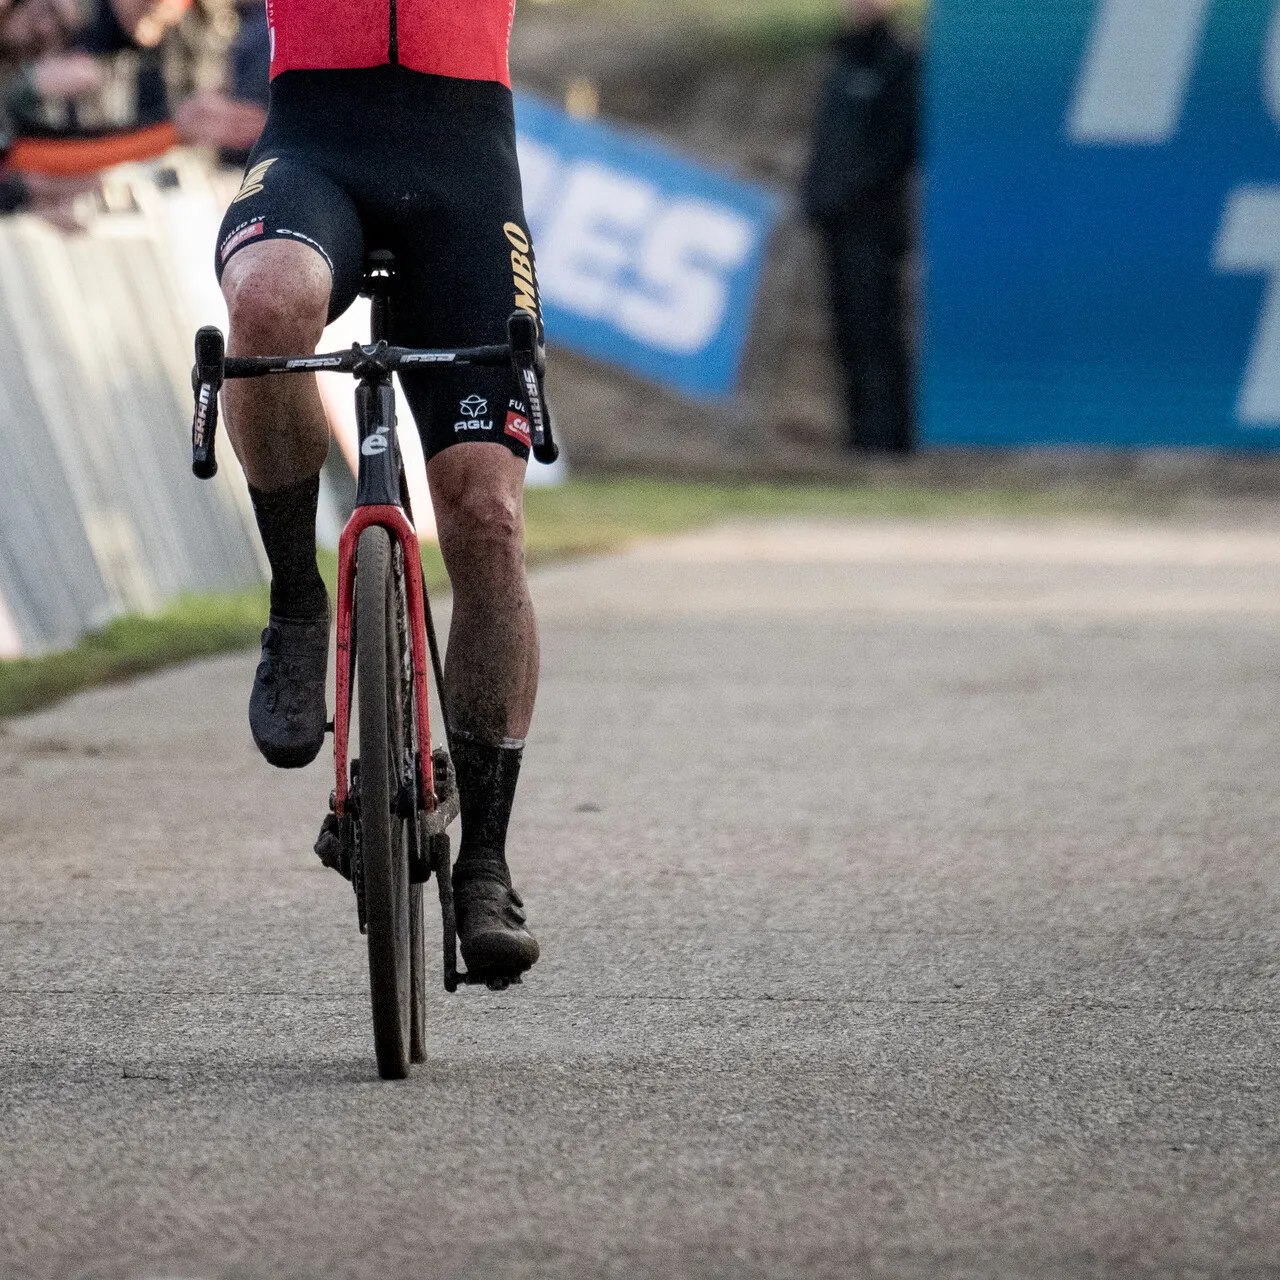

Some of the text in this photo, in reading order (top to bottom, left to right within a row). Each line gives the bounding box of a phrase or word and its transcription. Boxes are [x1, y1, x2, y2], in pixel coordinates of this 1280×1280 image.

[503, 222, 538, 320] MBO
[195, 383, 211, 448] SRAM
[454, 420, 493, 432] AGU
[523, 369, 544, 432] SRAM
